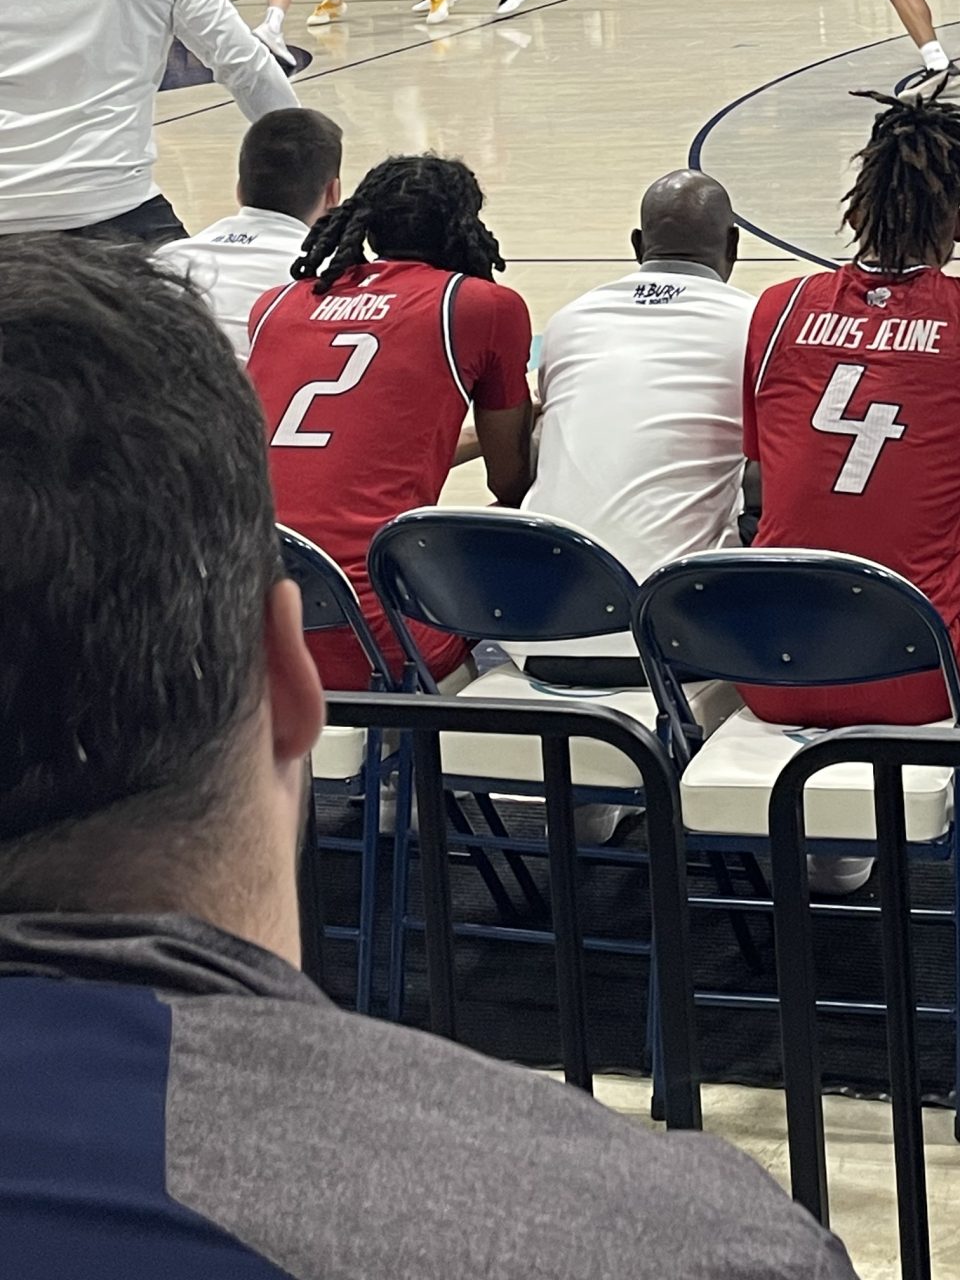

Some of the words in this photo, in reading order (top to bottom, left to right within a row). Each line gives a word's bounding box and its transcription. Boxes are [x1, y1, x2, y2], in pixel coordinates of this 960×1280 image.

[309, 293, 398, 321] HARRIS
[633, 282, 687, 300] #BURN
[795, 312, 869, 349] LOUIS
[865, 318, 948, 353] JEUNE
[270, 331, 380, 448] 2
[811, 363, 906, 495] 4
